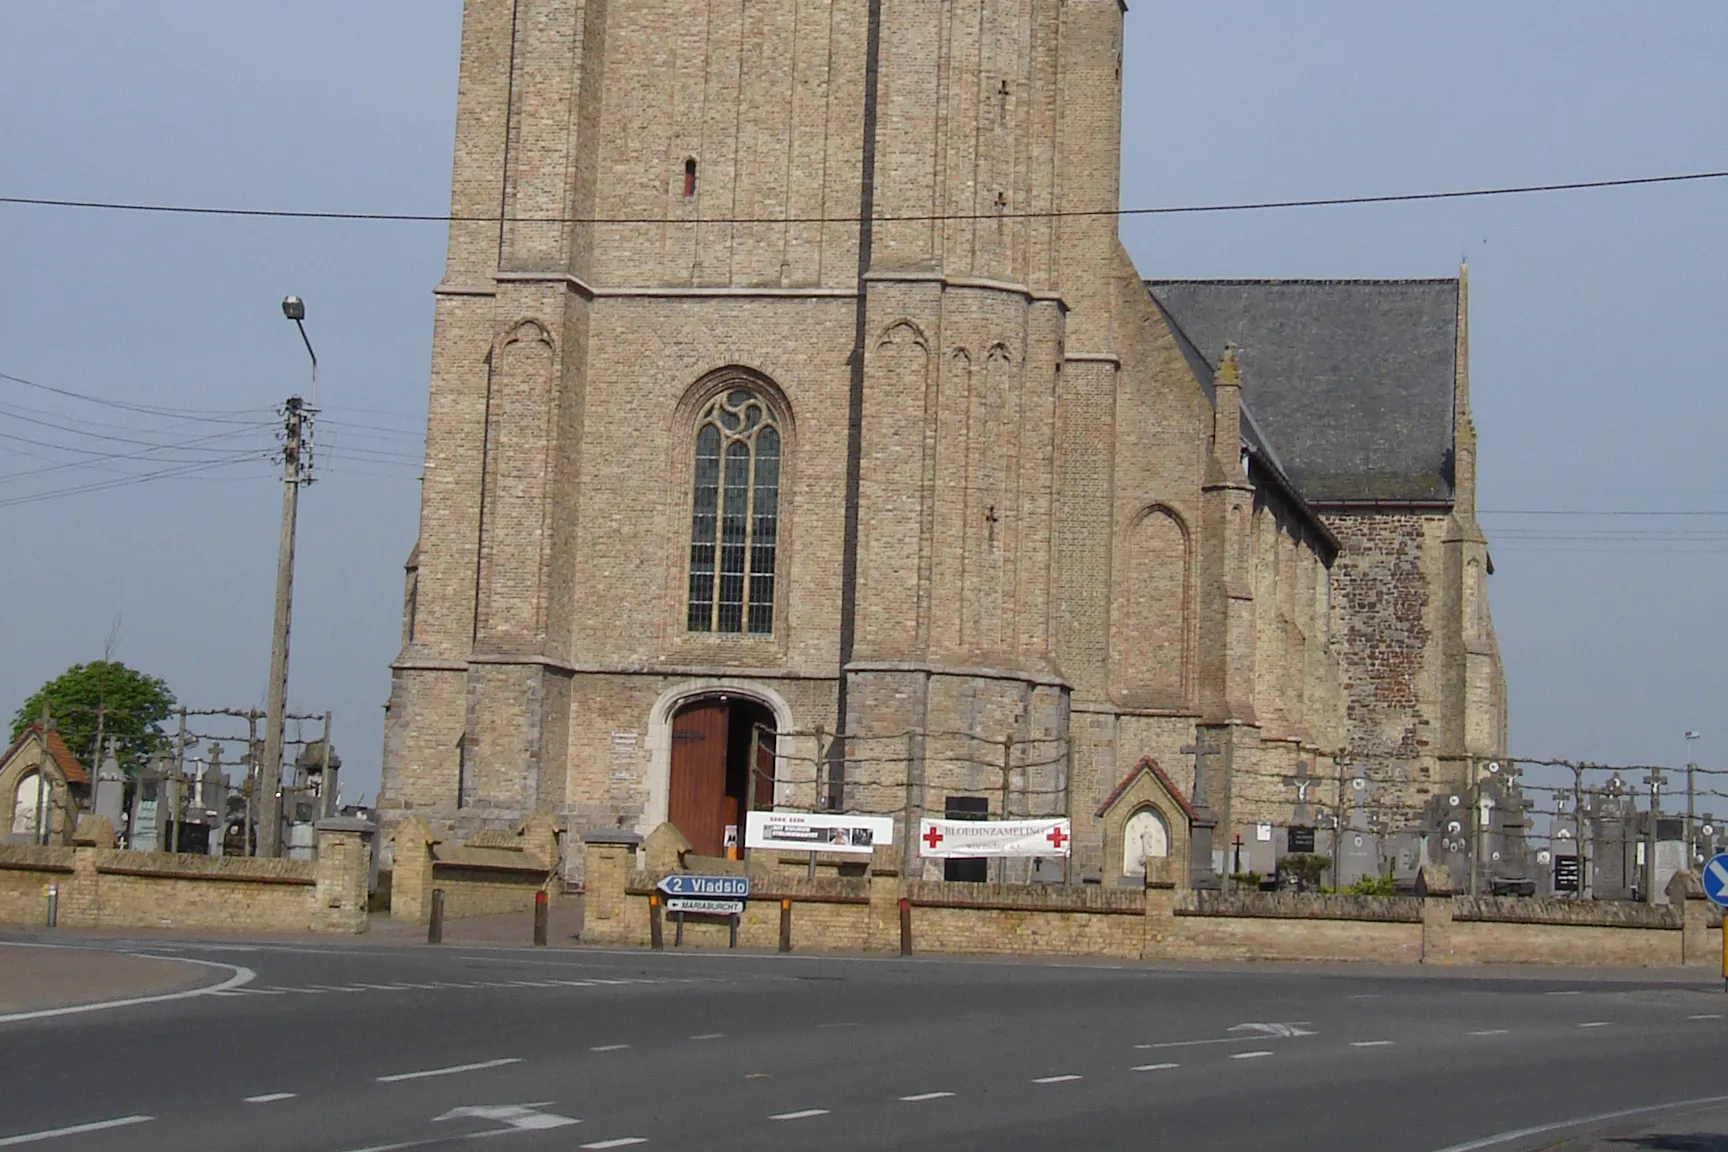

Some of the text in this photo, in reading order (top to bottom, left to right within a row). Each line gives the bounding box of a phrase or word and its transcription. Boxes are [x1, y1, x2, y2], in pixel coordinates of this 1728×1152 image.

[673, 878, 746, 893] 2 Vladslo
[681, 900, 739, 911] MARIABURCHT
